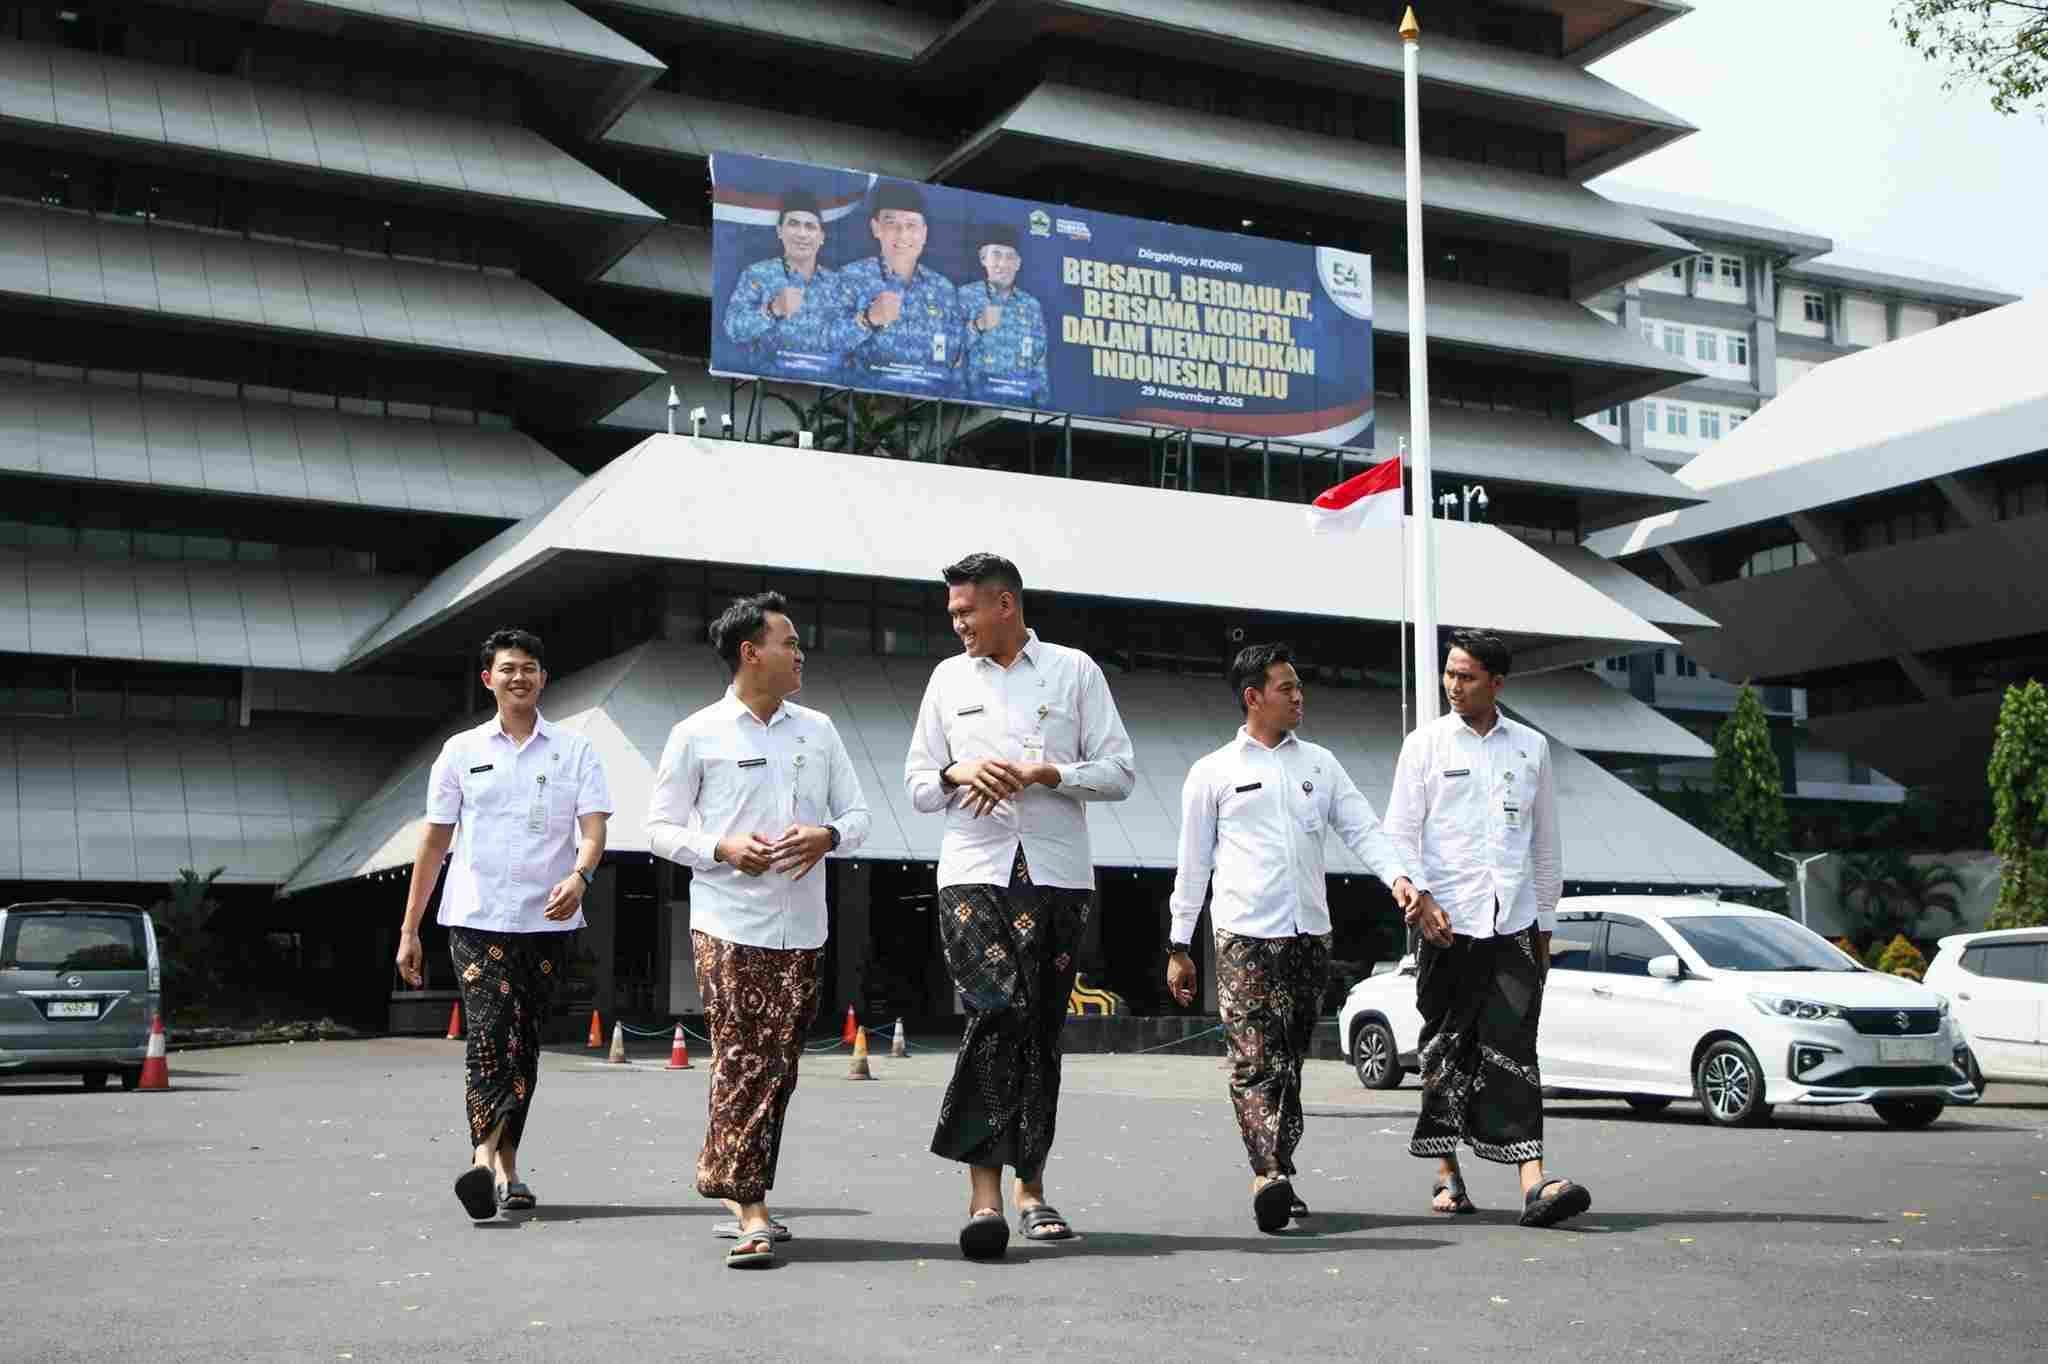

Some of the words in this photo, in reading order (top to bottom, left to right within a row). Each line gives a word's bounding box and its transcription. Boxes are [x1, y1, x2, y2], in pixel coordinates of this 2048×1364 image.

[1063, 256, 1176, 303] BERSATU,
[1138, 248, 1198, 268] Dirgahayu
[1199, 257, 1243, 273] KORPRI
[1332, 261, 1360, 288] 54
[1084, 288, 1200, 331] BERSAMA
[1063, 315, 1145, 352] DALAM
[1152, 328, 1315, 375] MEWUJUDKAN
[1093, 348, 1222, 392] INDONESIA
[1226, 366, 1289, 400] MAJU
[1141, 385, 1156, 396] 29
[1158, 387, 1216, 404] November
